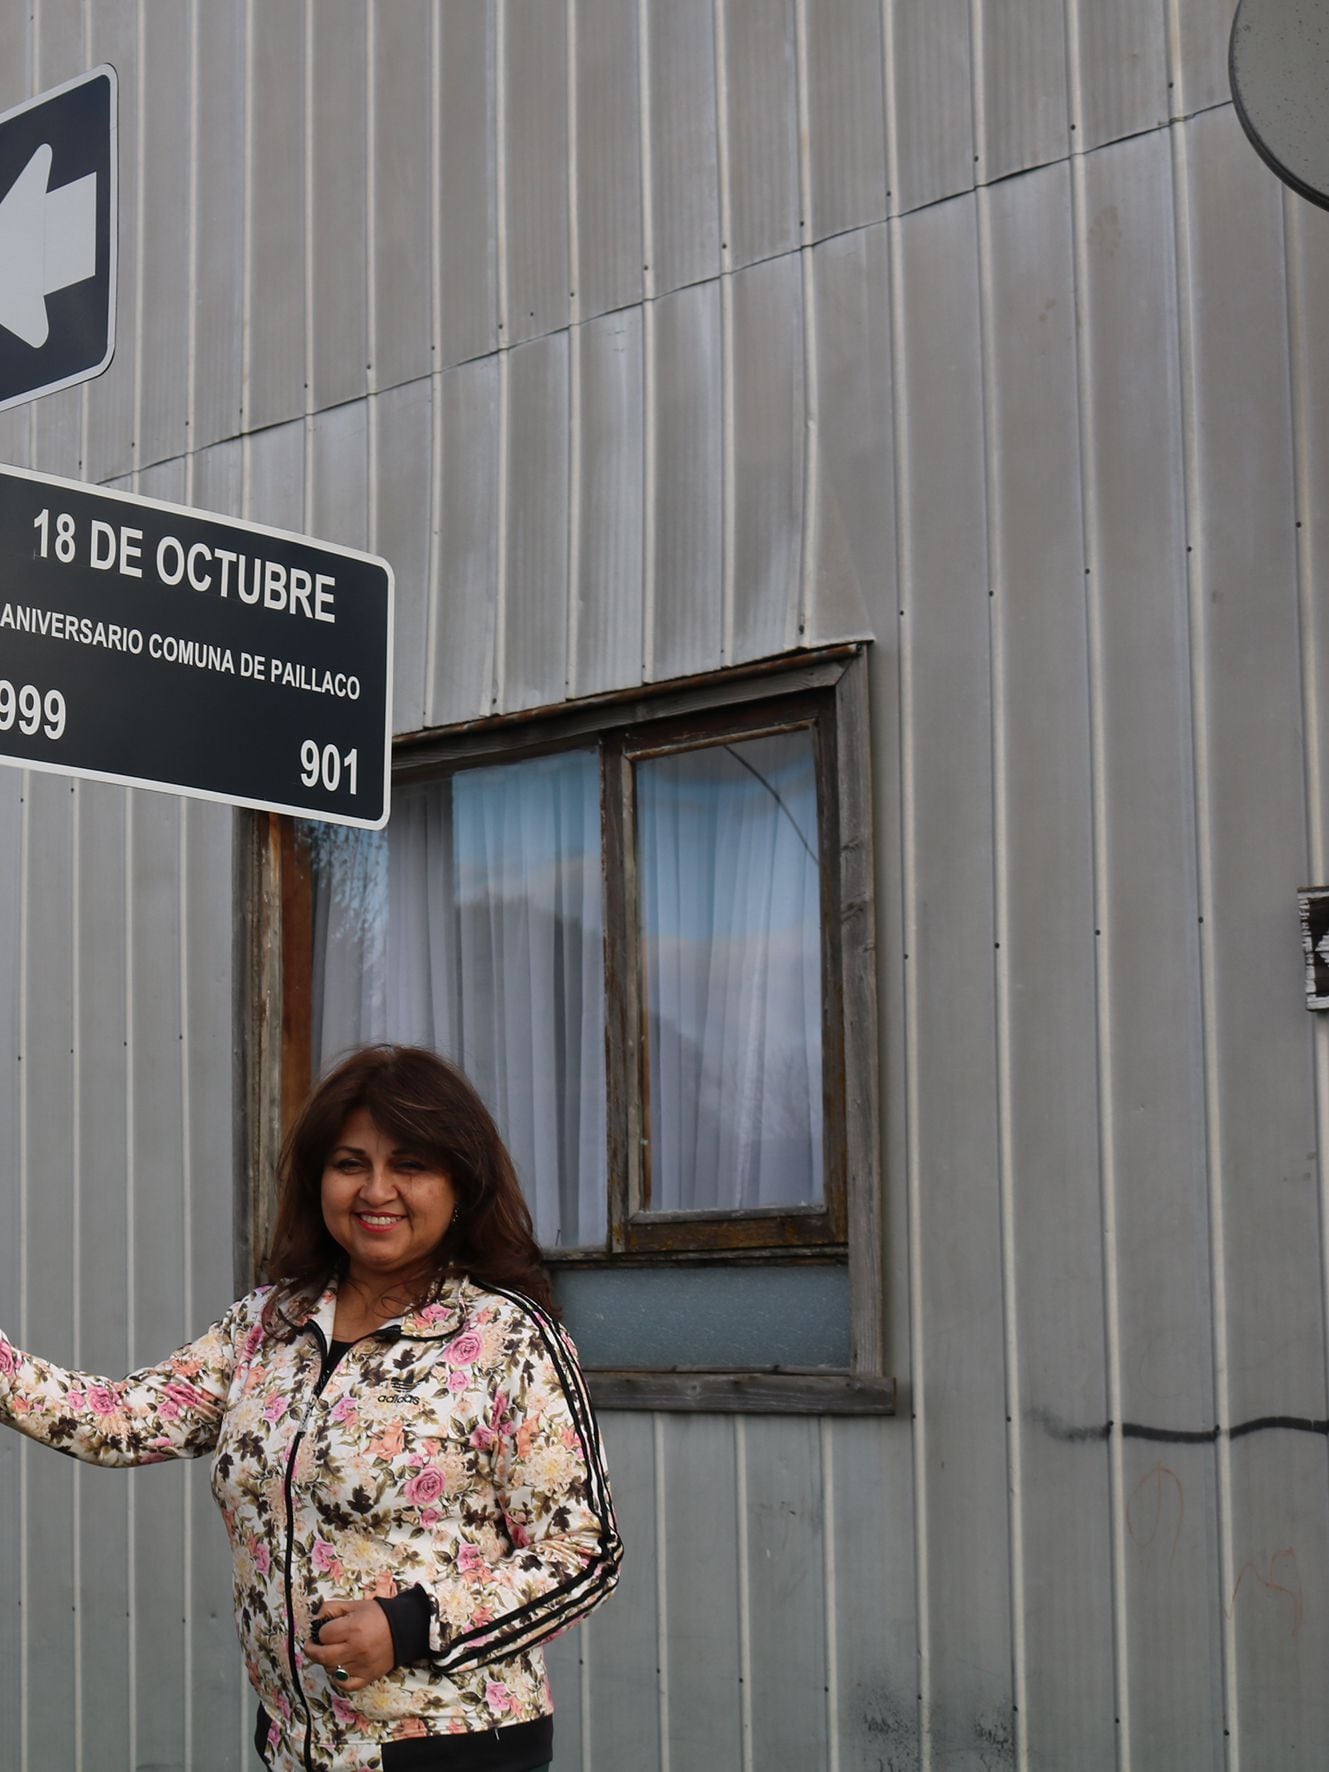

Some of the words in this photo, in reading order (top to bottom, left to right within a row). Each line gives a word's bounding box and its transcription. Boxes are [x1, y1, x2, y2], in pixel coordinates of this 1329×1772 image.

[33, 507, 76, 563] 18
[90, 519, 144, 578] DE
[156, 536, 336, 623] OCTUBRE
[0, 603, 144, 655] ANIVERSARIO
[149, 633, 235, 675] COMUNA
[240, 652, 266, 681] DE
[271, 658, 361, 701] PAILLACO
[299, 739, 359, 795] 901
